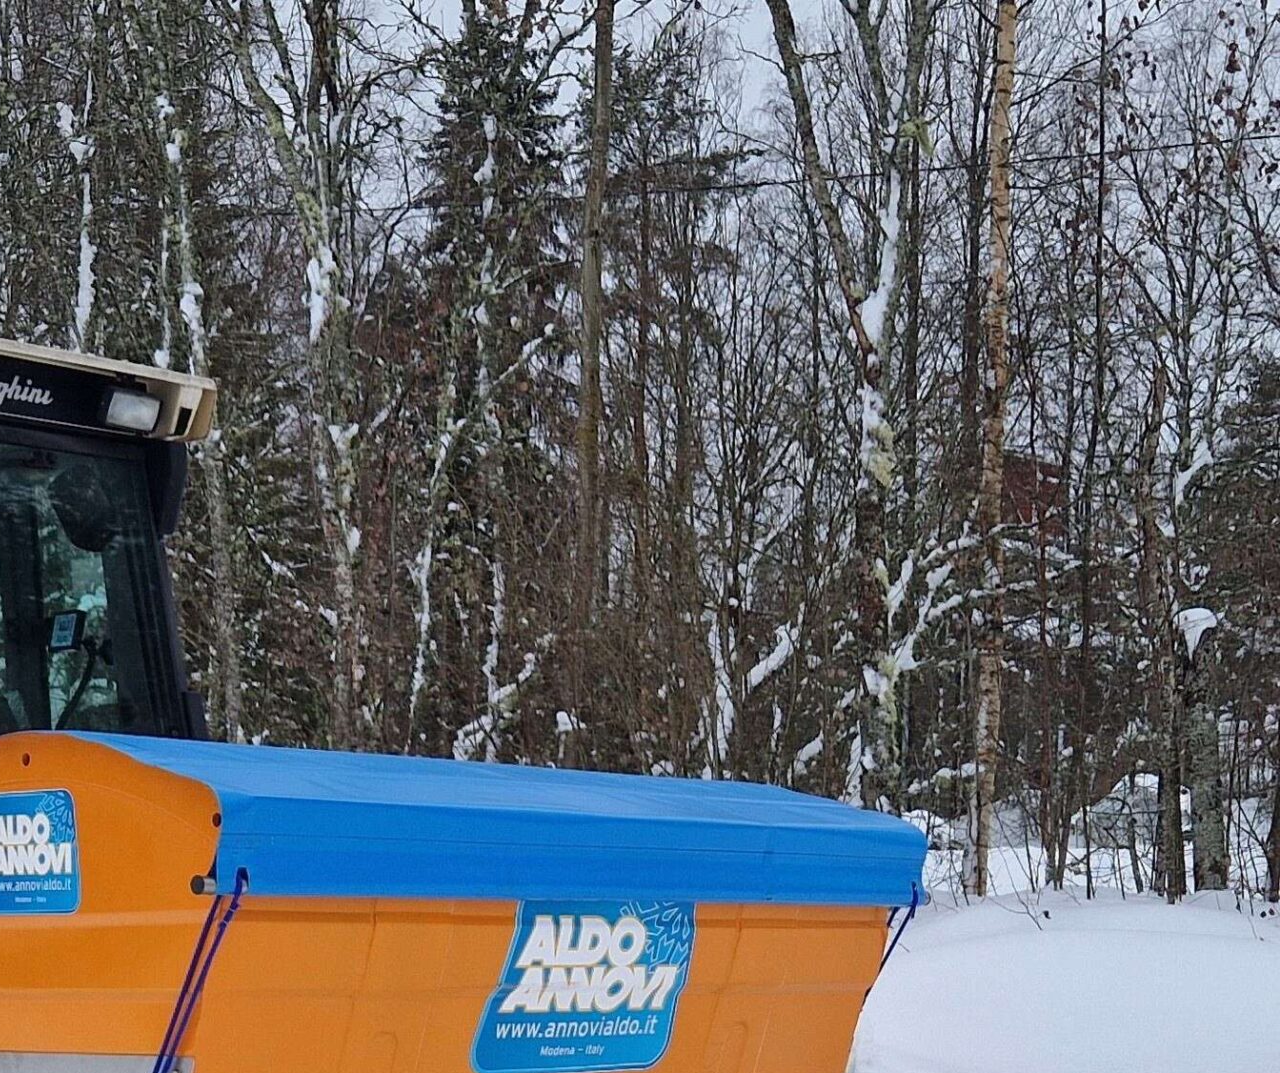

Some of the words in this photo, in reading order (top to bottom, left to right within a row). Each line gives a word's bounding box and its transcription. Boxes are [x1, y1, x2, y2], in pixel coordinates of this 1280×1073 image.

[516, 916, 647, 967] ALDO
[498, 965, 678, 1013] ANNOVI
[496, 1016, 658, 1040] www.annovialdo.it
[540, 1045, 574, 1056] Modena
[585, 1044, 605, 1056] Italy
